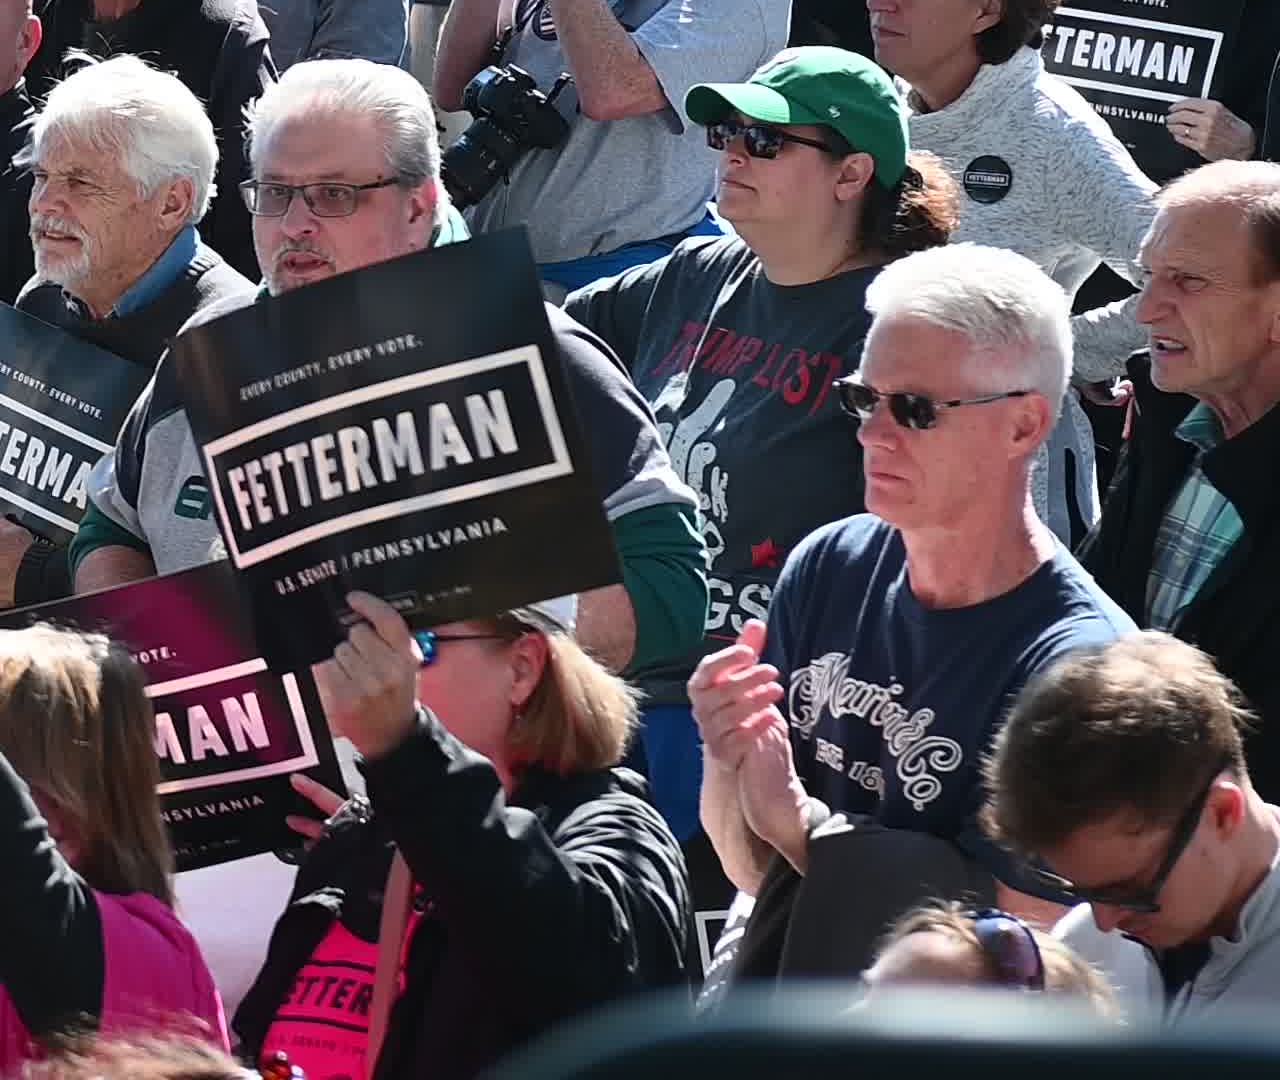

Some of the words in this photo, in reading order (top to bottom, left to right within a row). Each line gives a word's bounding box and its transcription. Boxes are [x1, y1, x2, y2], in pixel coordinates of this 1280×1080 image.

[229, 389, 518, 531] FETTERMAN
[352, 517, 508, 568] PENNSYLVANIA
[153, 692, 270, 764] MAN
[161, 795, 265, 824] NSYLVANIA
